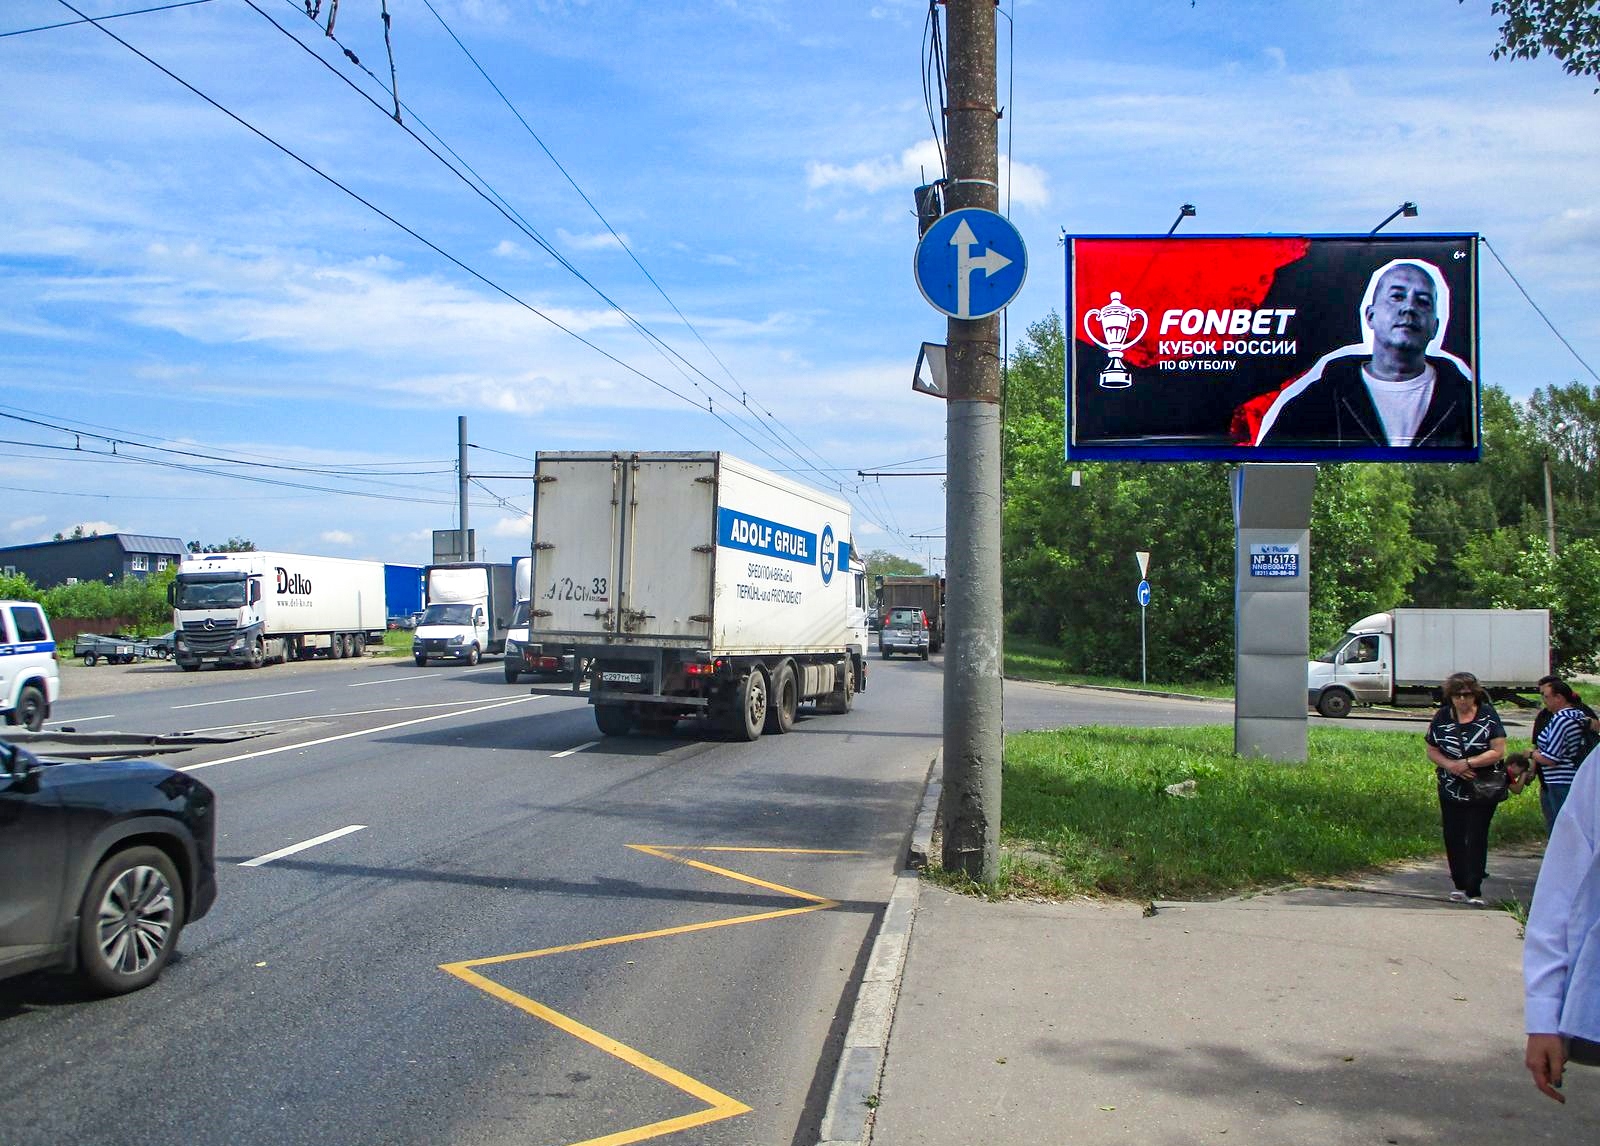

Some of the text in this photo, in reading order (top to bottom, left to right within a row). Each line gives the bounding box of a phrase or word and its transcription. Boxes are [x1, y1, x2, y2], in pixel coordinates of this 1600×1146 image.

[1453, 250, 1466, 260] 6+
[1160, 309, 1296, 335] FONBET
[1159, 340, 1297, 355] КУБОК РОССИИ
[1159, 360, 1237, 370] ПО ФУТБОЛУ
[731, 518, 808, 557] ADOLF GRUEL
[1269, 555, 1296, 564] 16173
[274, 566, 312, 596] Delko
[592, 578, 607, 595] 33
